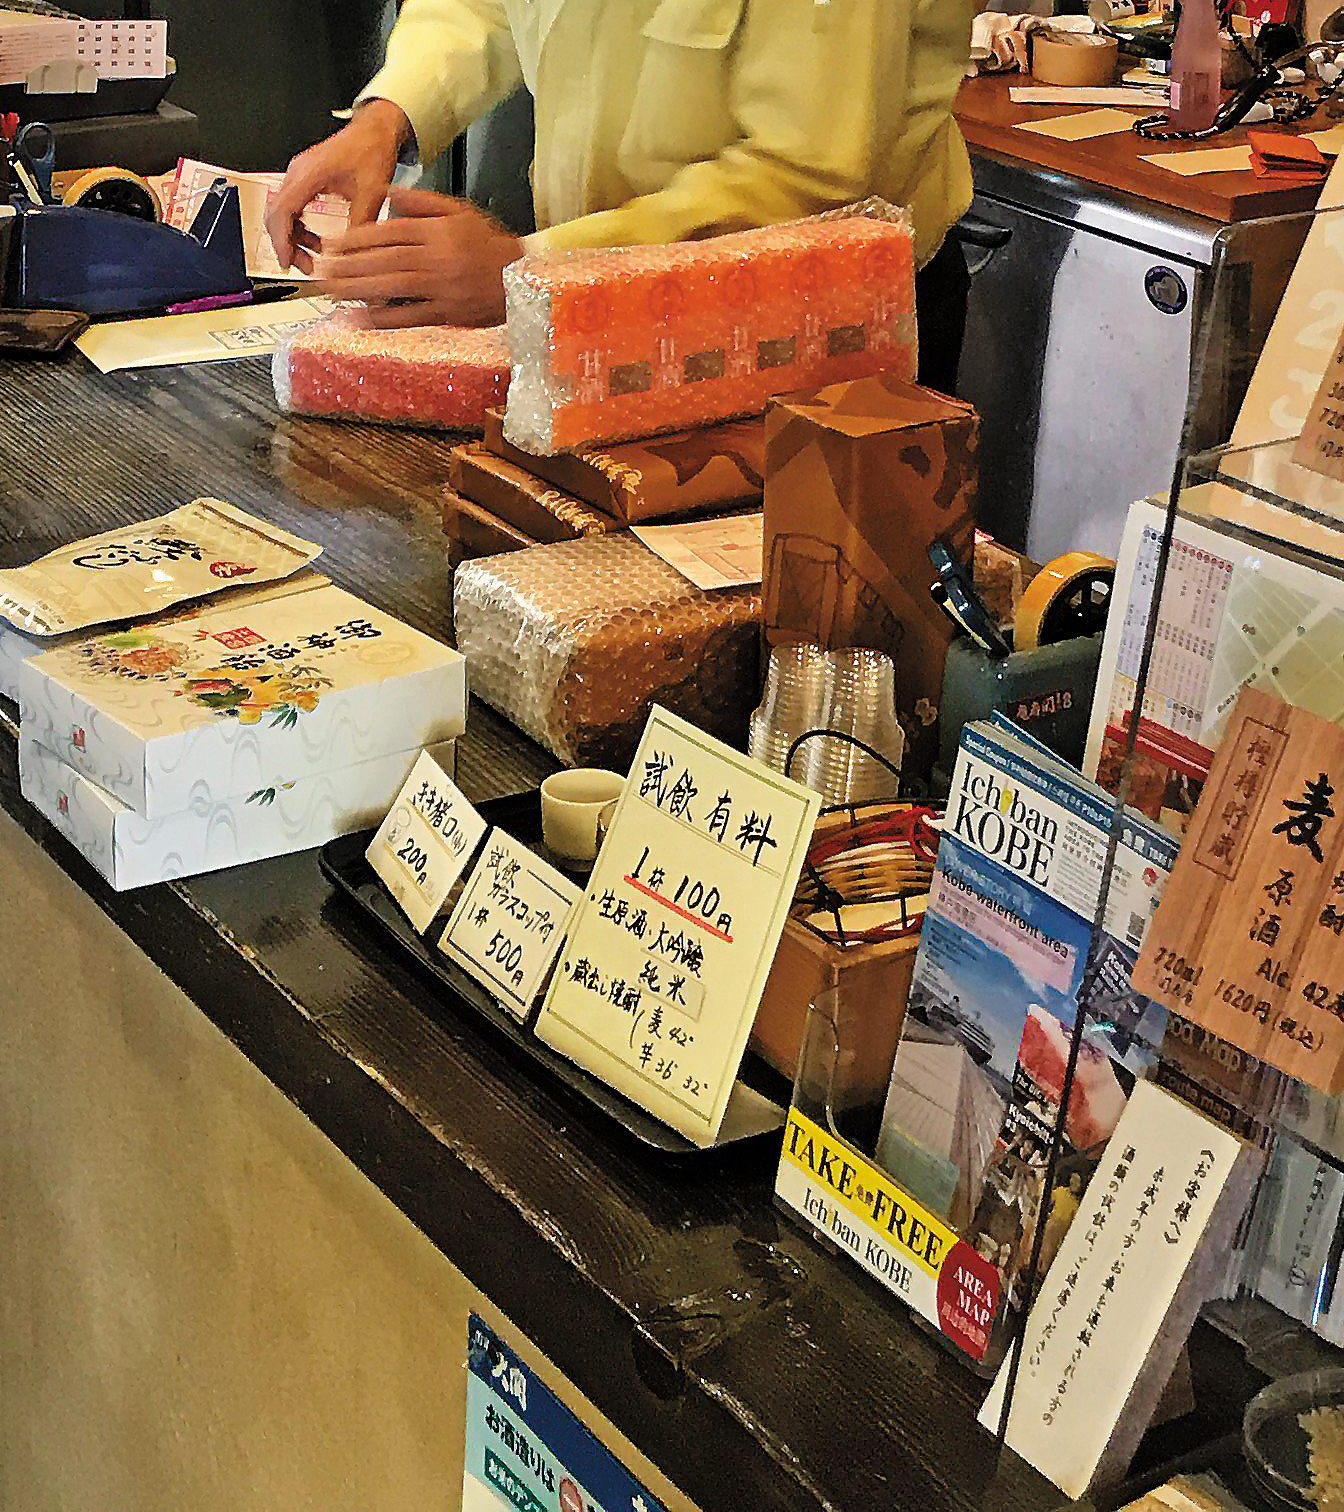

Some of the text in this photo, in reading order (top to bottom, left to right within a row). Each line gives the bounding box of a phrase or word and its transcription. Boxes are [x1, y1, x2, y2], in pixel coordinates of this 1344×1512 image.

[639, 750, 777, 868] 試飲有料
[397, 838, 428, 886] 200円
[487, 845, 521, 888] 試飲
[953, 793, 1055, 888] KOBE
[1248, 772, 1335, 949] 麦 原酒
[674, 875, 732, 940] 100円
[942, 868, 974, 897] Kobe
[976, 894, 1039, 939] waterfront
[1040, 932, 1070, 960] area
[485, 929, 525, 988] 500円
[639, 960, 687, 1007] 純米
[1153, 947, 1204, 987] 720ml
[788, 1120, 944, 1271] TAKE FREE
[864, 1237, 914, 1294] KOBE
[953, 1265, 994, 1310] AREA
[956, 1289, 992, 1328] MAP
[484, 1403, 556, 1493] お酒造りは
